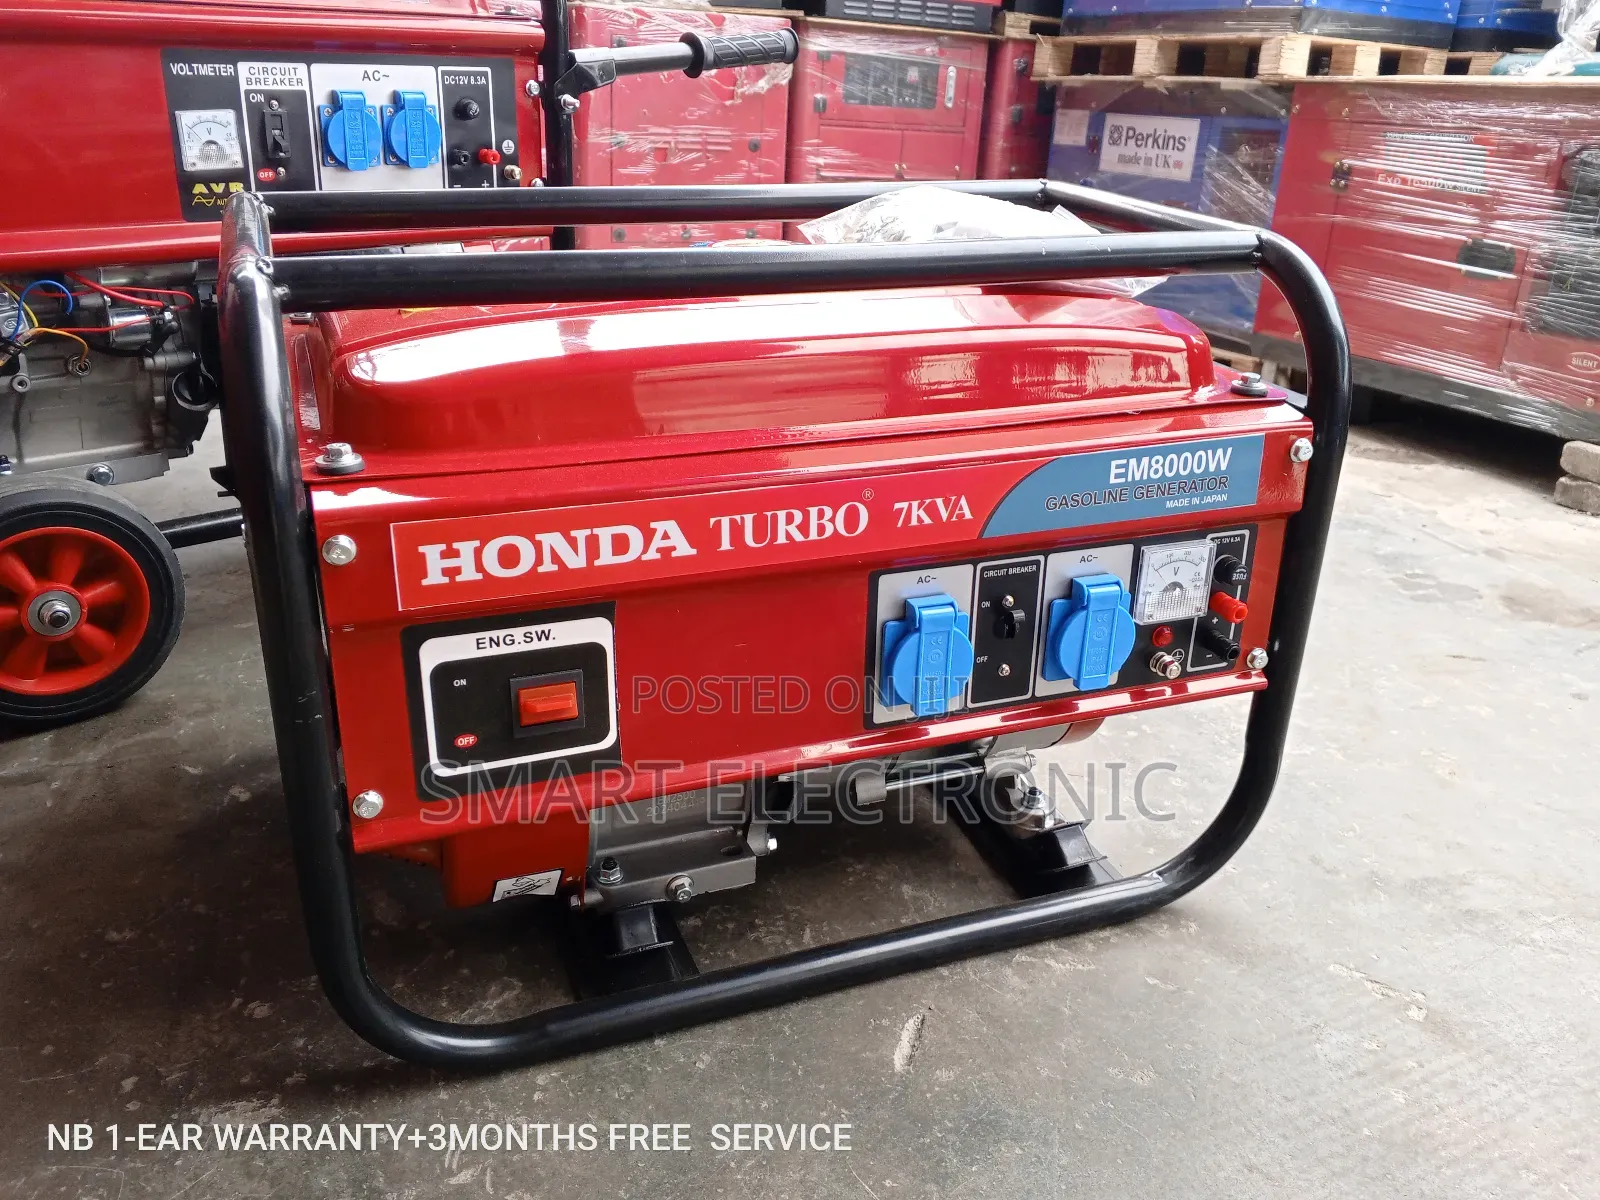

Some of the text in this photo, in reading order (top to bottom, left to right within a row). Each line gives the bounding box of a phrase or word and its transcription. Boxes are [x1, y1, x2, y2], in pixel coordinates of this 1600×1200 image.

[170, 62, 234, 76] VOLTMETER
[248, 66, 299, 77] CIRCUIT
[246, 77, 304, 87] BREAKER
[444, 75, 487, 85] DC12V 8.3A
[249, 92, 265, 103] ON
[1124, 126, 1187, 152] Perkins
[1117, 152, 1173, 169] made in UK
[259, 171, 274, 179] OFF
[192, 182, 245, 194] AVR
[1571, 356, 1599, 369] SILENT
[1109, 447, 1233, 485] EM8000W
[1044, 475, 1229, 512] GASOLINE GENERATOR
[1165, 493, 1228, 510] MADE IN JAPAN
[418, 495, 974, 587] HONDA TURBO 7KVA
[983, 564, 1037, 579] CIRCUIT BREAKER
[981, 600, 991, 609] ON
[475, 628, 557, 651] ENG.SW.
[976, 655, 989, 664] OFF
[453, 678, 467, 687] ON
[457, 736, 475, 746] OFF
